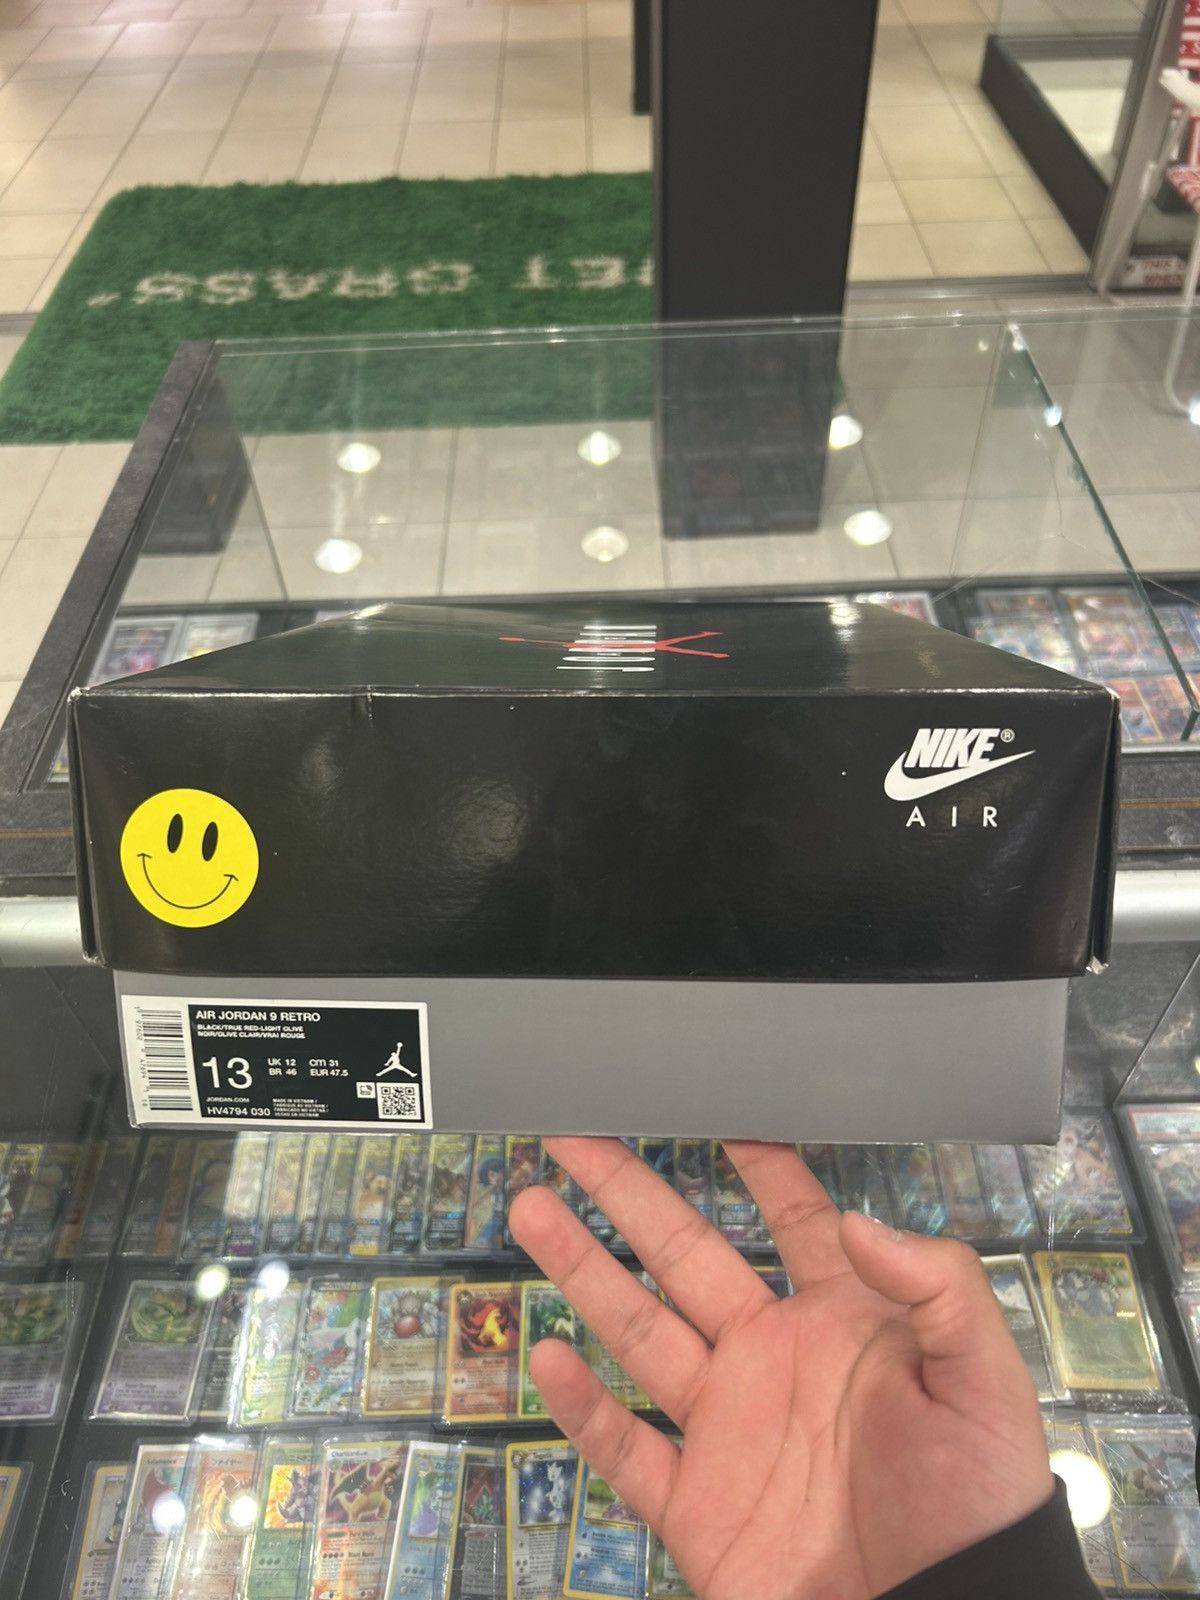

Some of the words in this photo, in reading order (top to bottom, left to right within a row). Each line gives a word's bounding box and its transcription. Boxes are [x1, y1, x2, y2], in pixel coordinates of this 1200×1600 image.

[510, 254, 654, 291] ET
[905, 805, 998, 828] AIR
[195, 1010, 216, 1020] AIR
[218, 1011, 267, 1021] JORDAN
[269, 1012, 278, 1021] 9
[280, 1012, 321, 1022] RETRO
[267, 1058, 282, 1066] UK
[285, 1058, 296, 1067] 12
[328, 1059, 339, 1067] 31
[202, 1056, 253, 1089] 13
[269, 1068, 282, 1076] BR
[285, 1068, 298, 1076] 46
[310, 1069, 329, 1077] EUR
[330, 1069, 349, 1077] 47.5
[207, 1107, 248, 1116] HV4794
[251, 1108, 271, 1116] 030
